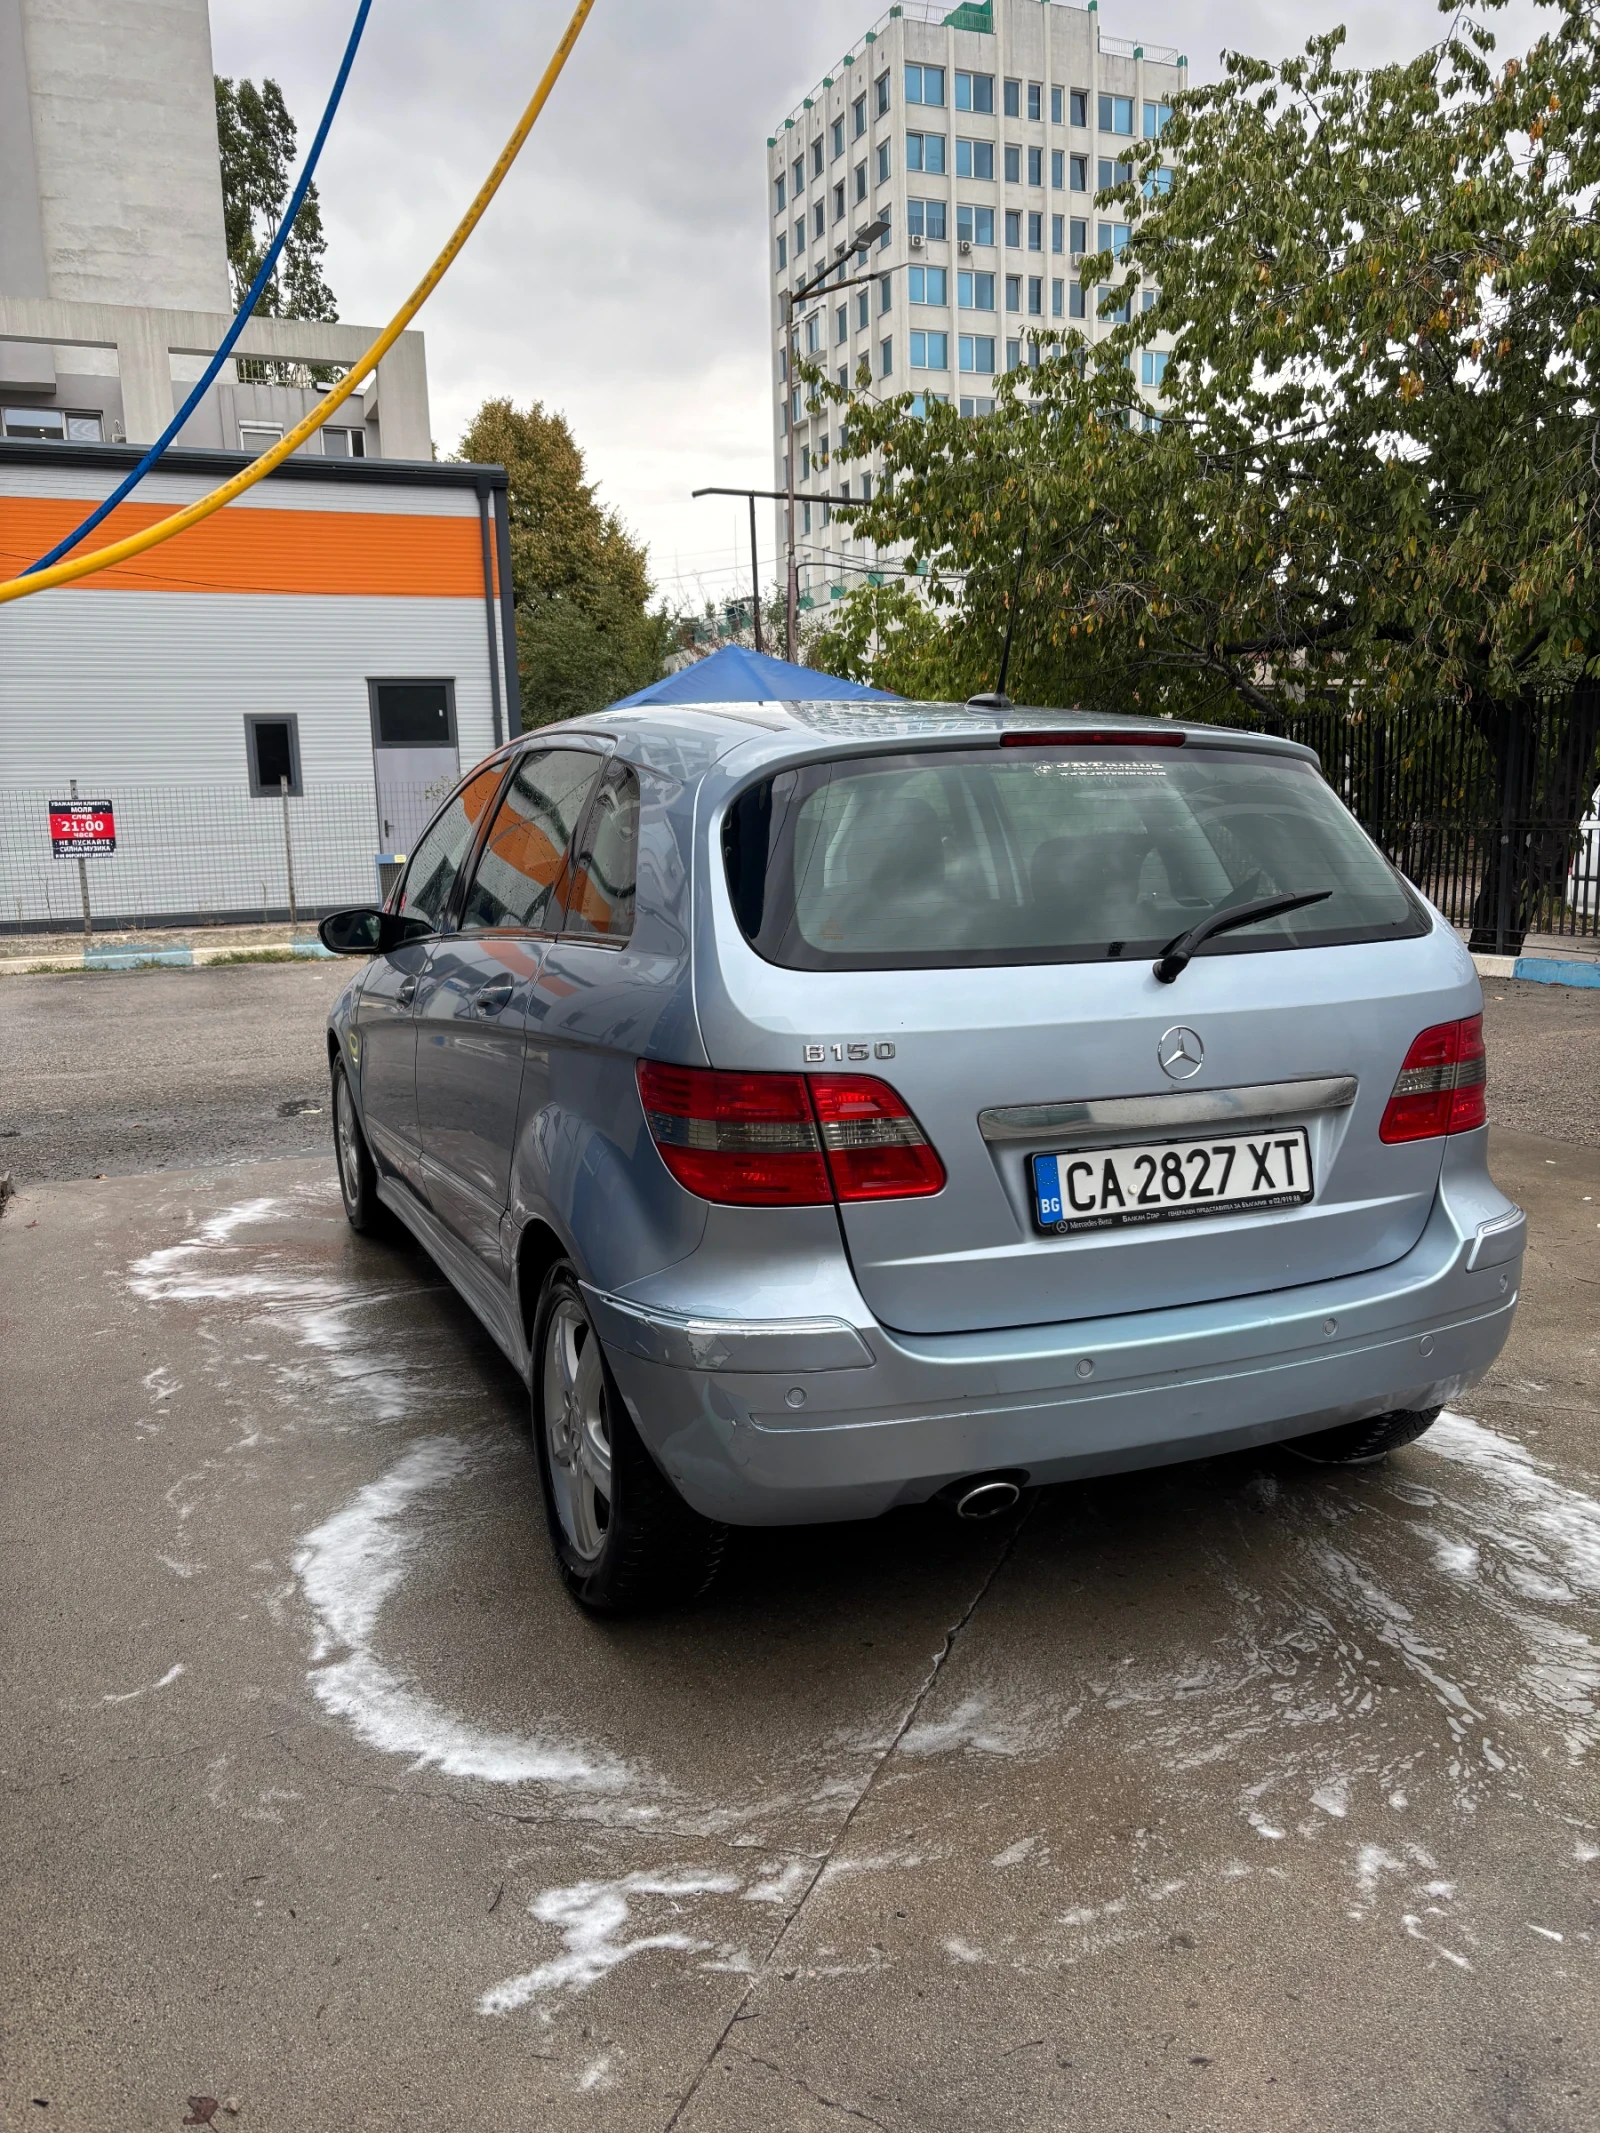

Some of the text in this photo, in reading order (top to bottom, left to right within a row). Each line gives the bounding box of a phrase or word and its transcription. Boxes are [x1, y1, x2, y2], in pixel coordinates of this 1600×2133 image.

[61, 820, 104, 832] 21:00
[72, 838, 111, 846] ПУСКАЙТЕ
[803, 1041, 896, 1063] B150
[1066, 1138, 1299, 1212] CA 2827 XT
[1041, 1198, 1060, 1215] BG
[1069, 1218, 1113, 1229] Mercedes-Benz
